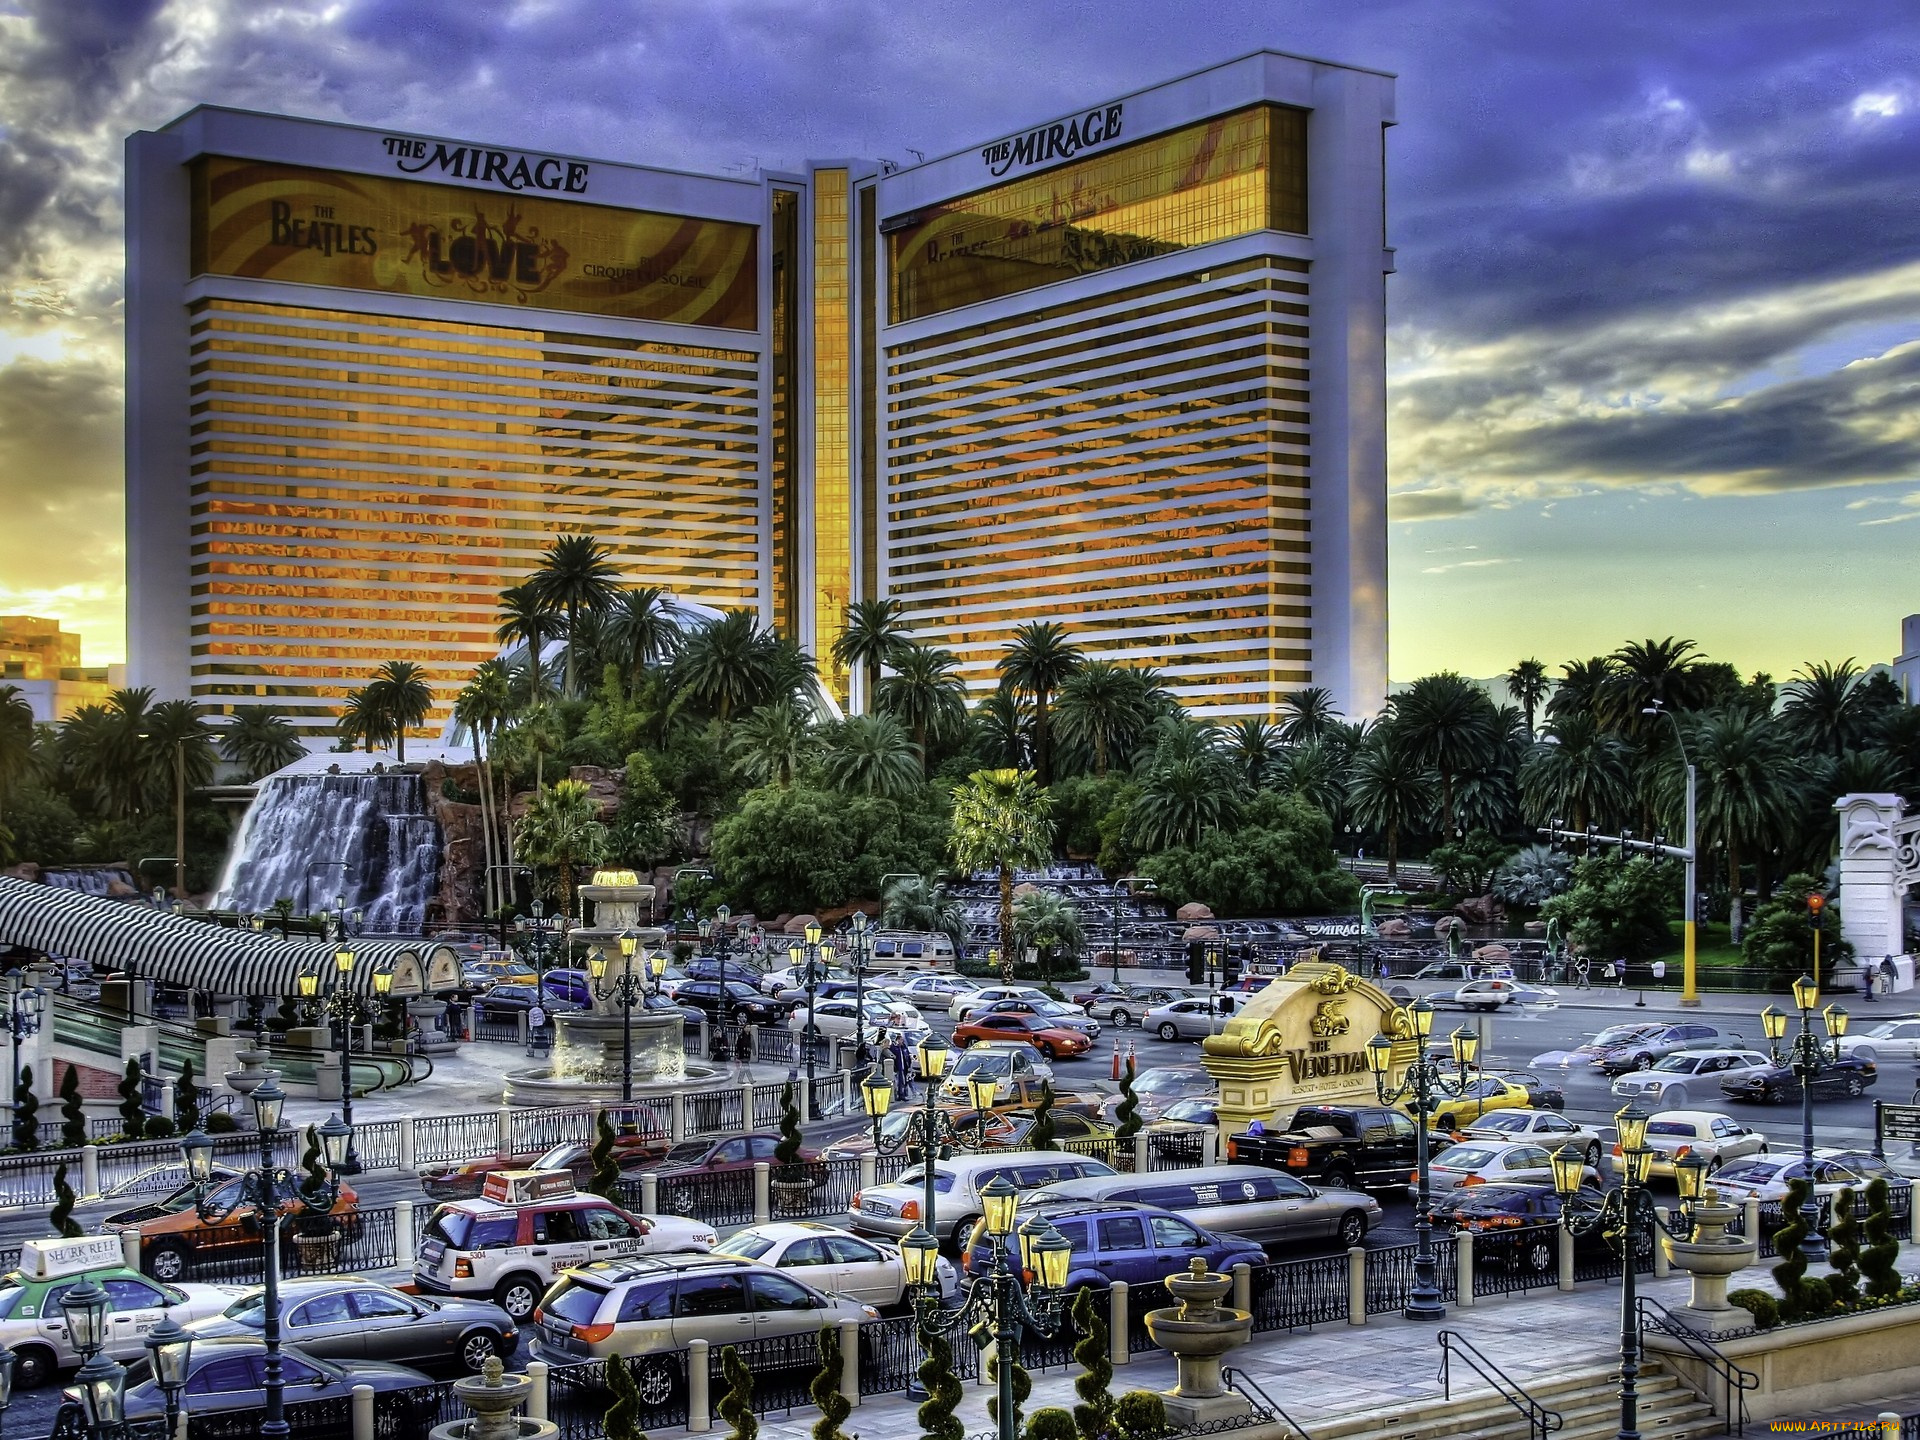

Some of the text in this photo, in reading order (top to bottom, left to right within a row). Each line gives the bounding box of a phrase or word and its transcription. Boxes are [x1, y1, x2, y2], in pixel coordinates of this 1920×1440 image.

[982, 103, 1123, 177] THE MIRAGE
[383, 137, 589, 194] THE MIRAGE
[313, 205, 335, 219] THE
[271, 200, 378, 257] BEATLES
[428, 231, 541, 284] LOVE
[583, 263, 635, 281] CIRQUE
[661, 273, 708, 289] SOLEIL
[1310, 924, 1368, 937] MIRAGE
[1309, 1040, 1331, 1053] THE
[1319, 1081, 1338, 1091] HOTEL
[1342, 1078, 1364, 1088] CASINO
[609, 1239, 645, 1250] WHITTLESEA
[692, 1234, 707, 1243] 5304
[48, 1240, 115, 1261] SHARK REEF
[469, 1251, 486, 1260] 5304
